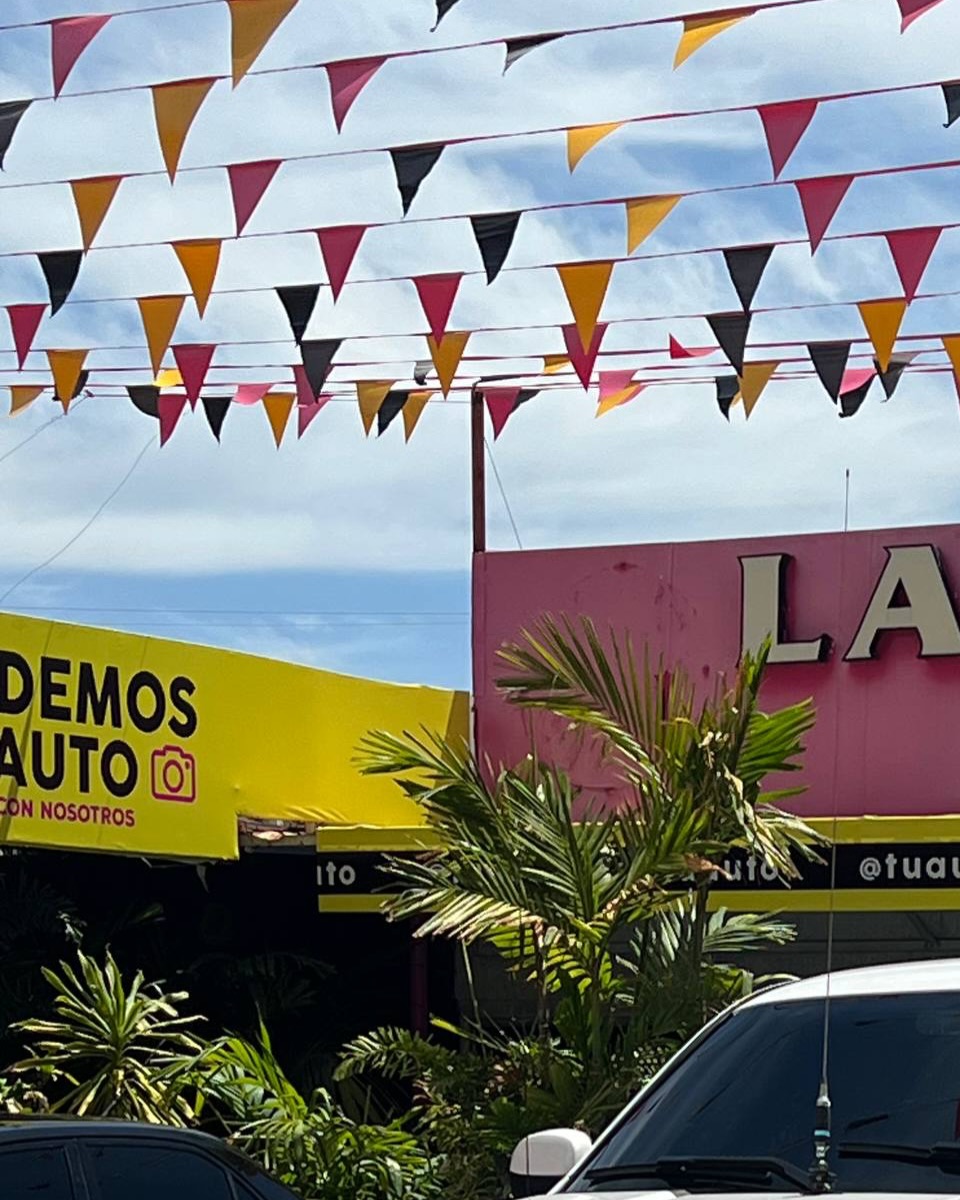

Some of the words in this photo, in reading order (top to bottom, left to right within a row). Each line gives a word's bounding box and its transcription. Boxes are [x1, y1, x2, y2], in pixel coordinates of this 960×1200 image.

[0, 650, 198, 738] DEMOS
[0, 726, 138, 797] AUTO
[40, 801, 136, 828] NOSOTROS
[316, 861, 356, 886] to
